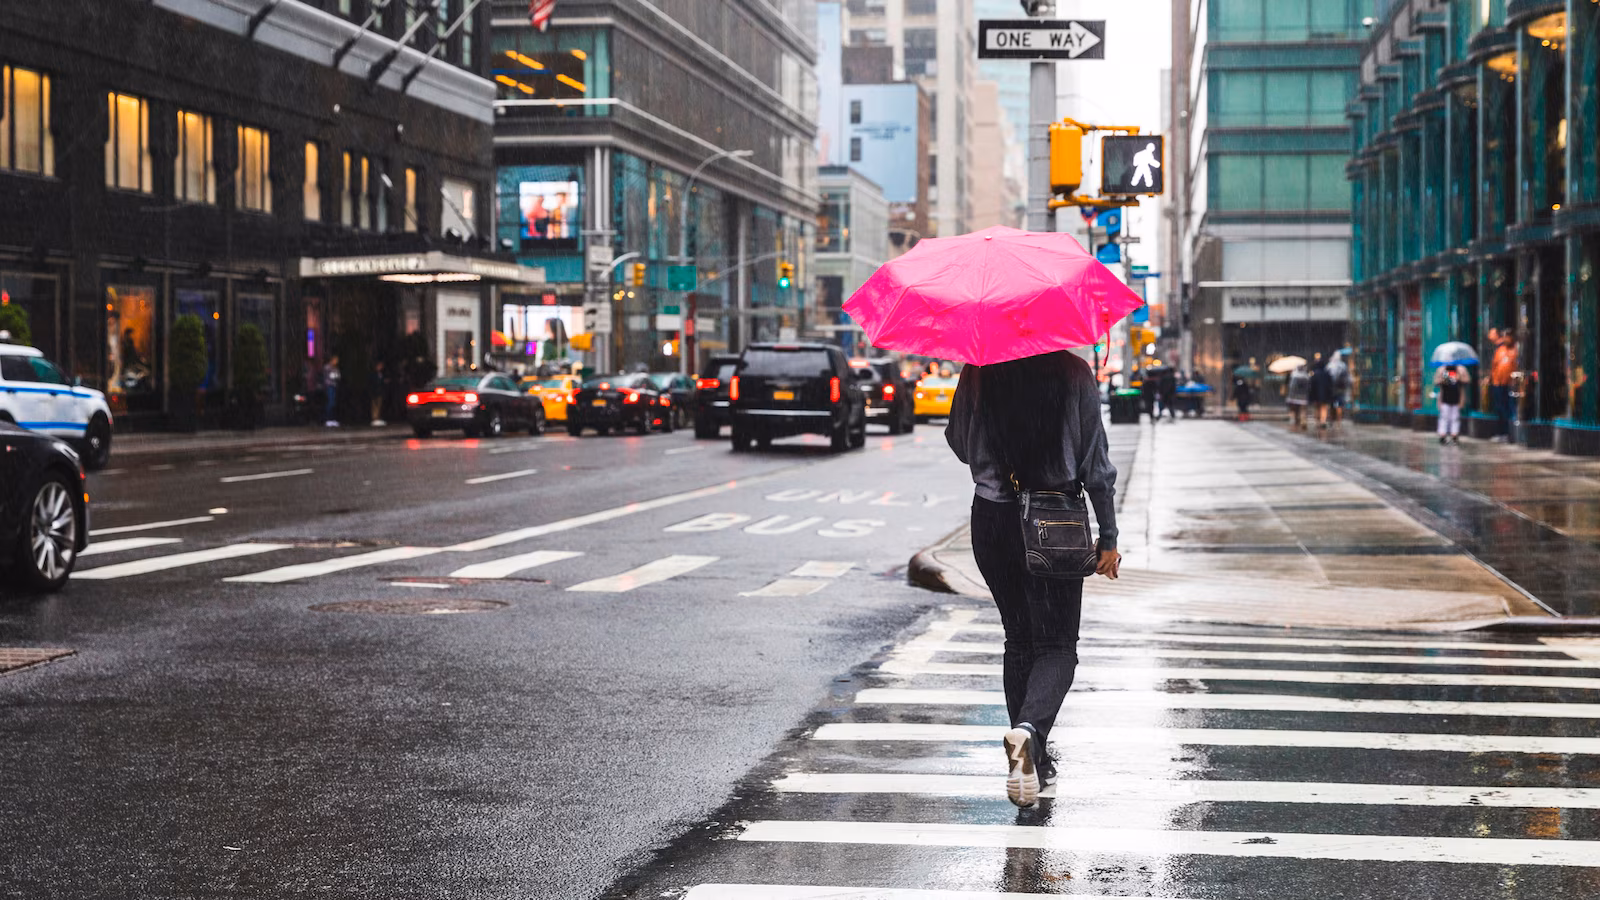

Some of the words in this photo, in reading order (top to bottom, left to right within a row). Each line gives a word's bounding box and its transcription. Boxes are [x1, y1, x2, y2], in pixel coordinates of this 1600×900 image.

[996, 31, 1032, 47] ONE
[1049, 32, 1086, 47] WAY
[764, 488, 958, 508] ONLY
[662, 512, 887, 538] BUS
